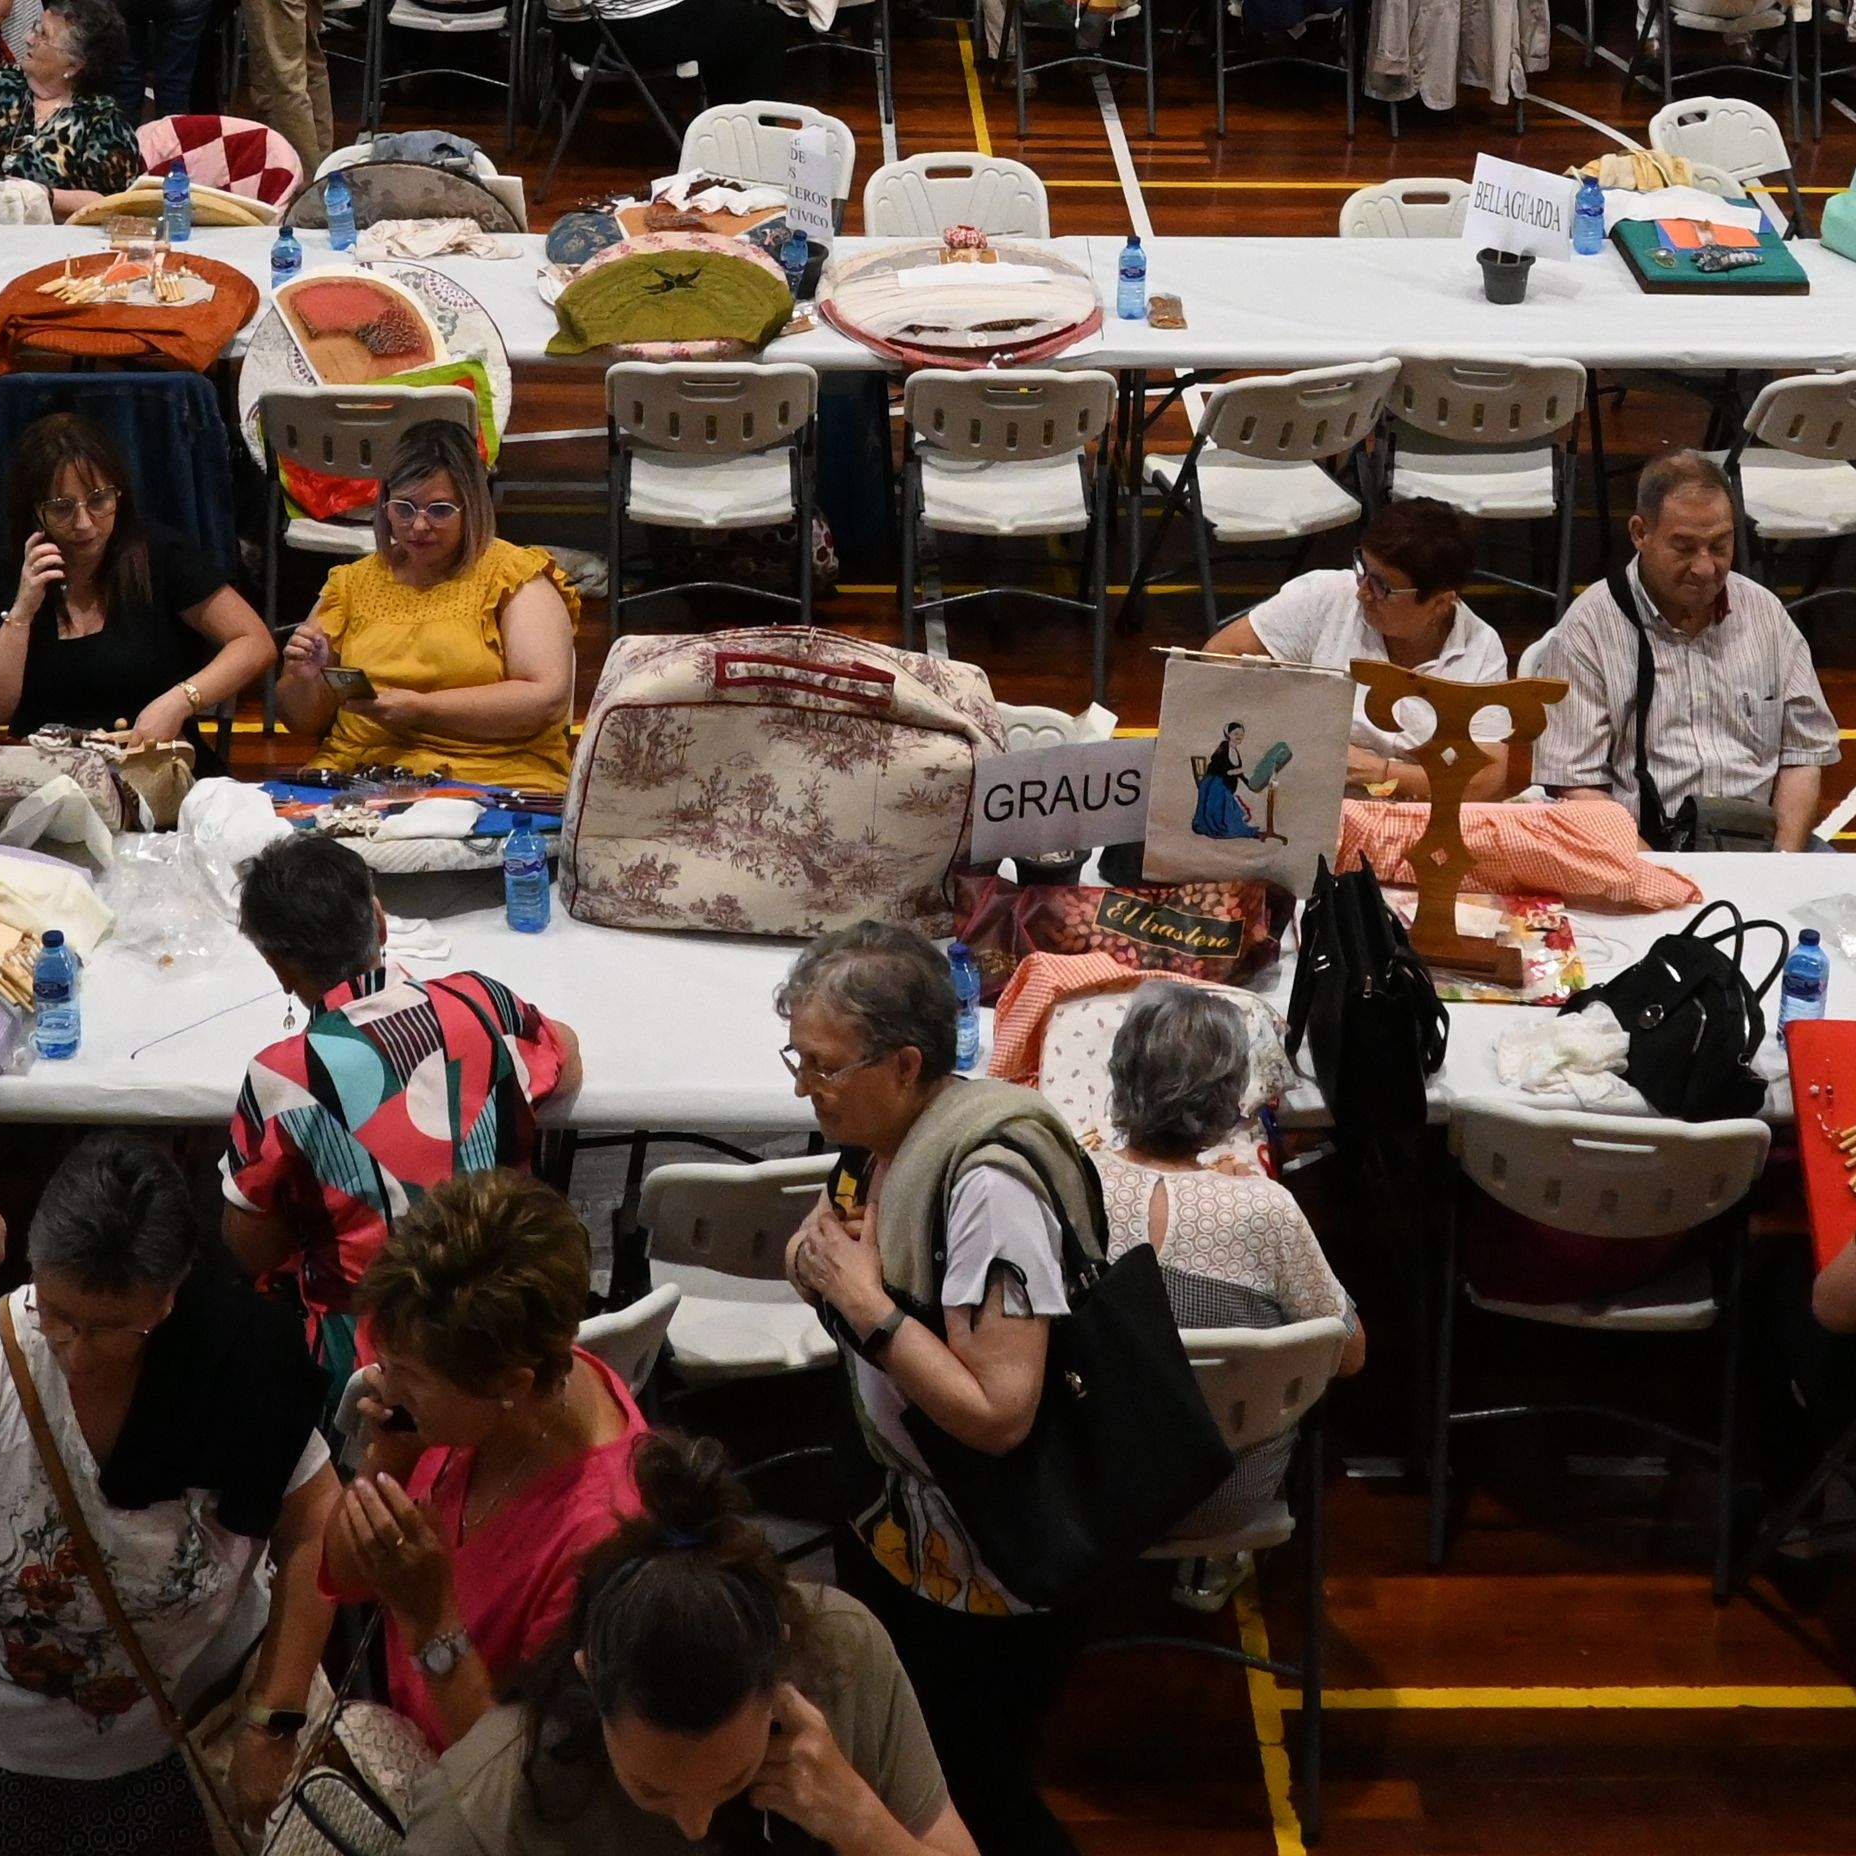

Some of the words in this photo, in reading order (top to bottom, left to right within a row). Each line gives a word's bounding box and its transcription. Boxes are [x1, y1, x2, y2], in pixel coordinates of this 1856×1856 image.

[1474, 180, 1561, 232] BELLAGUARDA
[983, 769, 1141, 823] GRAUS
[1105, 900, 1134, 925] El
[1138, 914, 1232, 949] trastero
